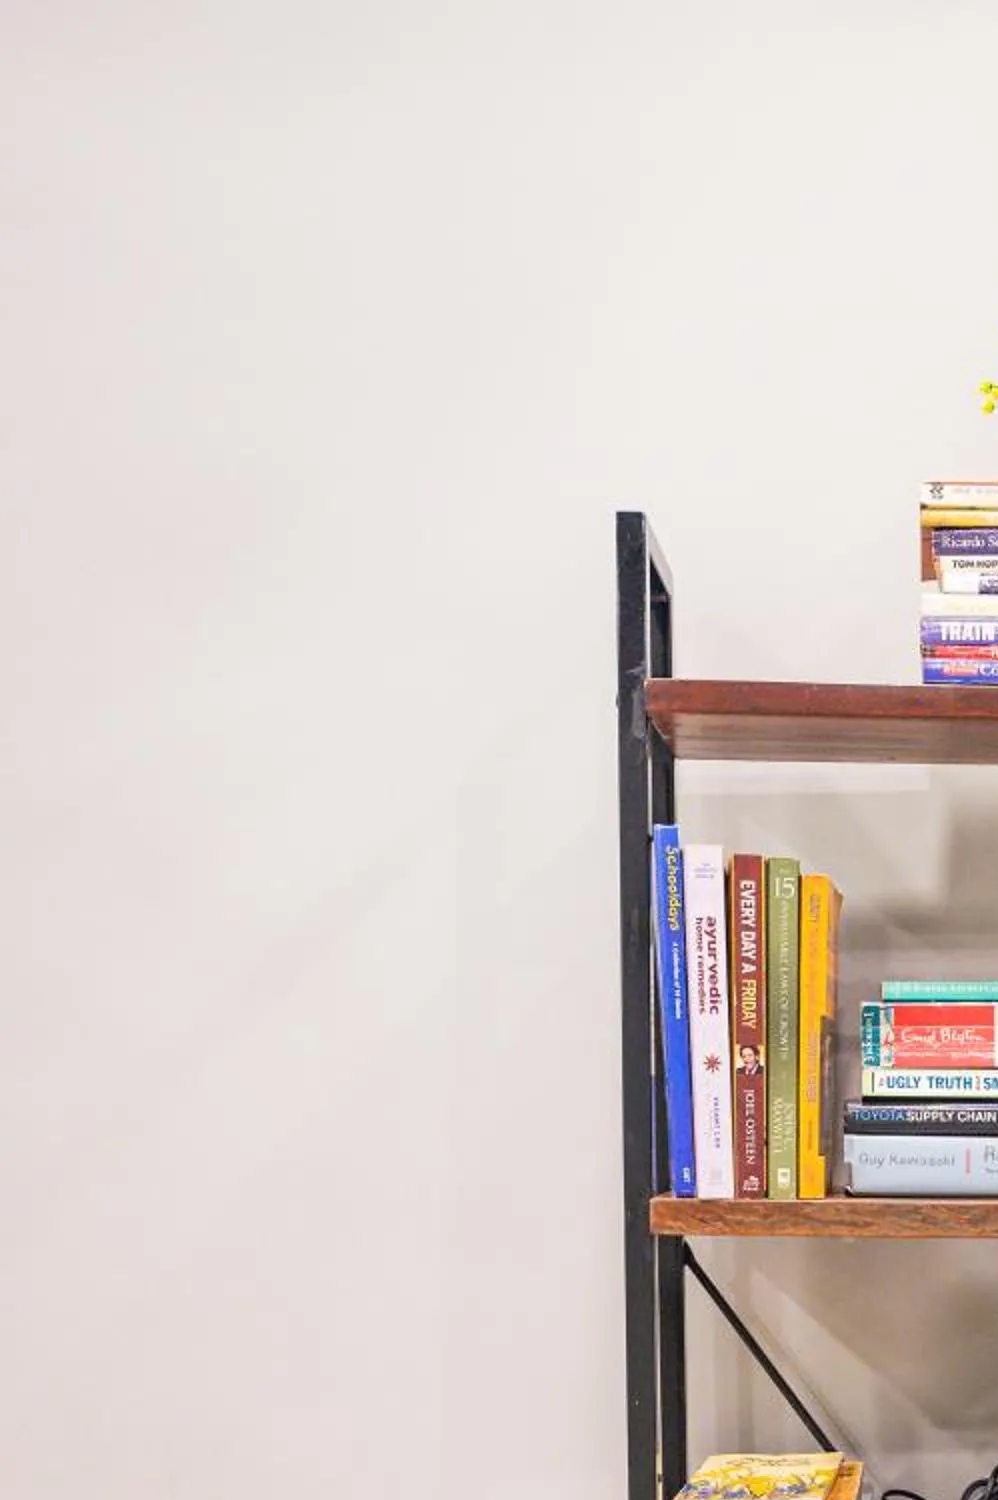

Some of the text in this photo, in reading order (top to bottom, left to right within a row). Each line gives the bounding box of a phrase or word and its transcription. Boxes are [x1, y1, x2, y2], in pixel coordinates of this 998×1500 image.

[941, 532, 985, 547] Ricardo
[952, 560, 974, 569] TOM
[939, 623, 993, 642] TRAIN
[662, 846, 680, 931] Schooldays
[774, 877, 796, 898] 15
[740, 880, 757, 1029] EVERY DAY A FRIDAY
[695, 917, 707, 1015] home remedies
[704, 916, 722, 1015] ayurvedic
[900, 1027, 936, 1047] Enid
[886, 1076, 920, 1090] UGLY
[927, 1076, 973, 1091] TRUTH
[743, 1089, 755, 1117] JOEL
[854, 1110, 905, 1121] TOYOTA
[906, 1111, 954, 1122] SUPPLY
[957, 1112, 997, 1123] CHAIN
[744, 1118, 756, 1165] OSTEEN
[858, 1154, 955, 1170] Guy Kawasaki
